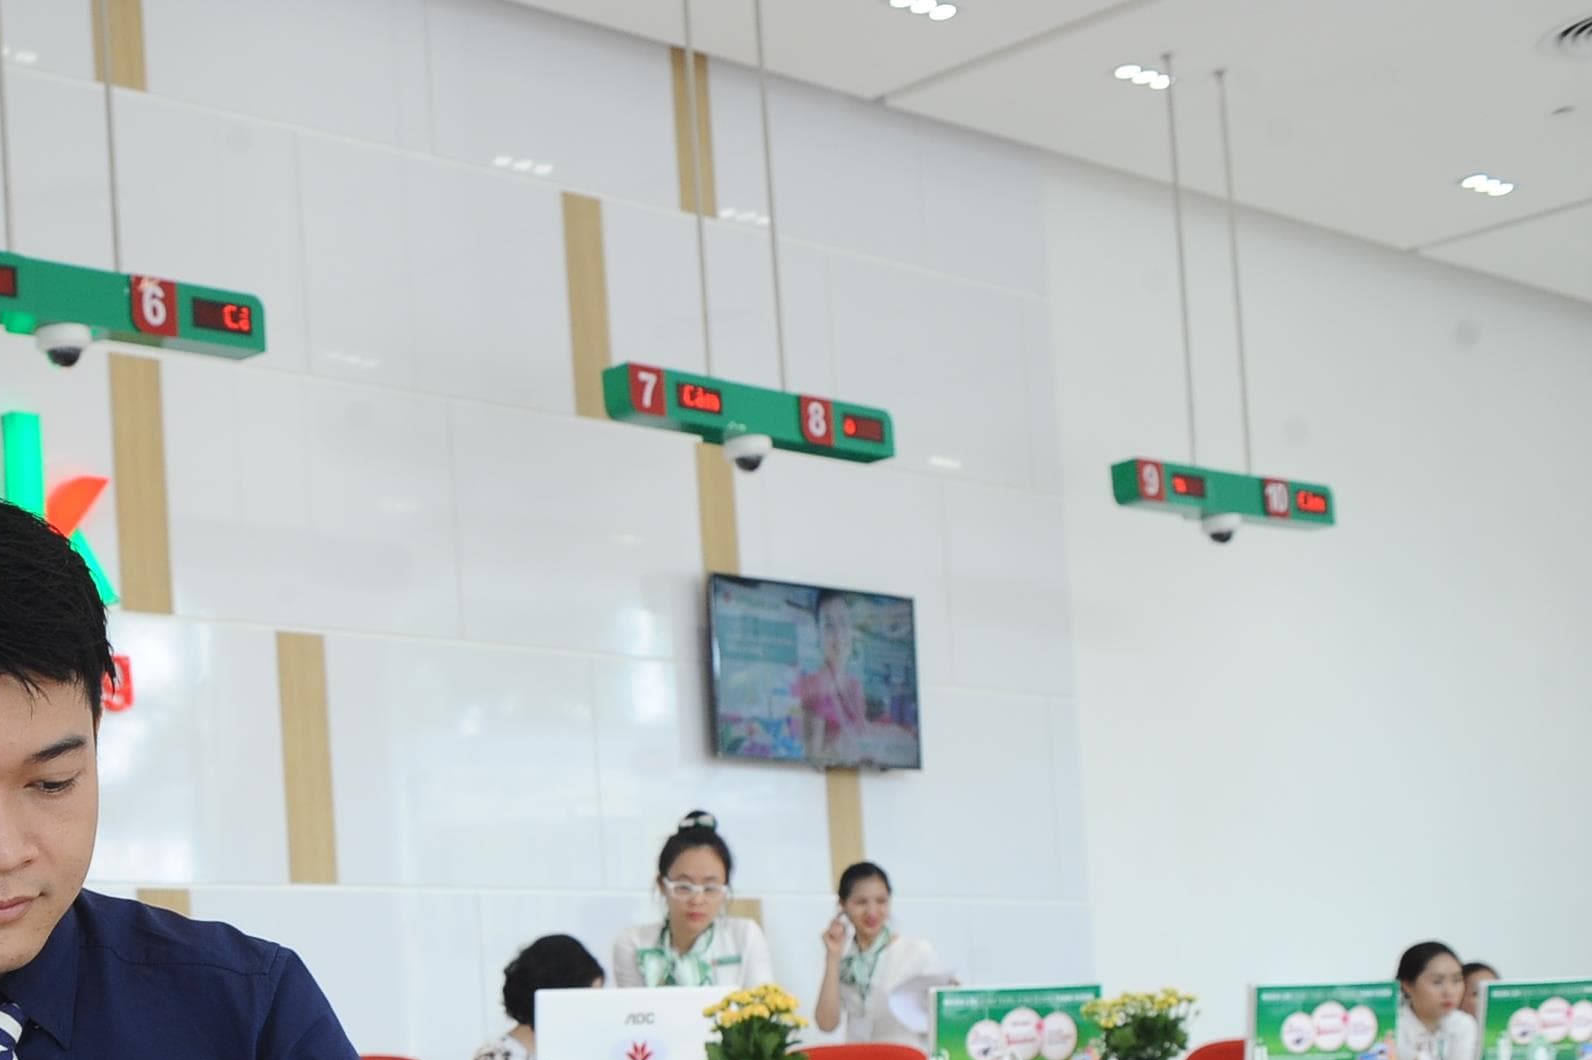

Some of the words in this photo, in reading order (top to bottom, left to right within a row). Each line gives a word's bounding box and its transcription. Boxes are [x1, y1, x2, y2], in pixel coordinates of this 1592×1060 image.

[142, 284, 167, 327] 6
[638, 371, 657, 408] 7
[808, 401, 825, 437] 8
[1143, 463, 1159, 496] 9
